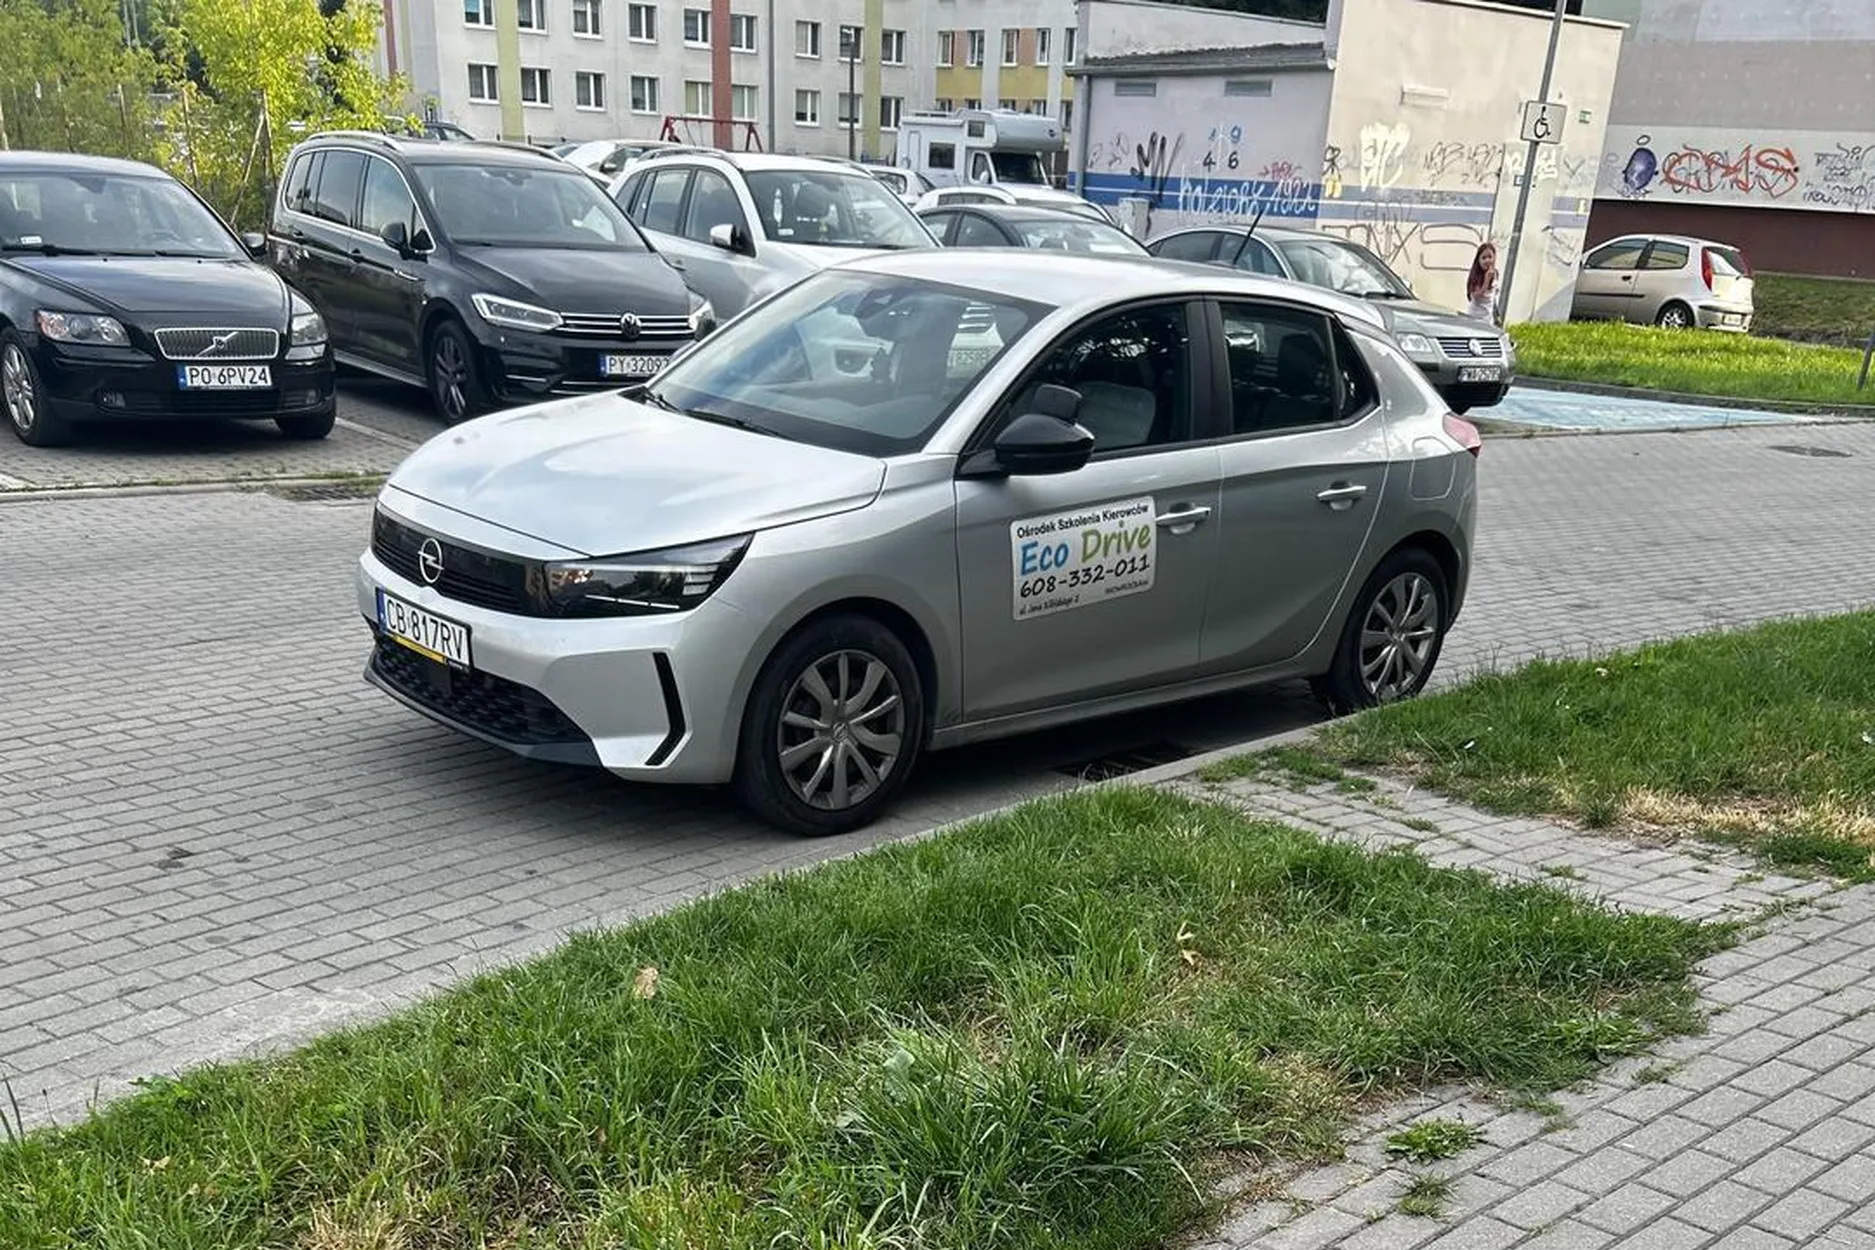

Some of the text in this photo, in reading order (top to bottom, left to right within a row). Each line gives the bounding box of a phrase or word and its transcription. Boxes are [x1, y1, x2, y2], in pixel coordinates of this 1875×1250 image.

[188, 367, 269, 385] PO 6PV24
[609, 357, 626, 372] PY
[1016, 503, 1149, 539] Ośrodek Szkolenia Kierowców
[1020, 520, 1151, 576] Eco Drive
[1020, 554, 1150, 598] 608-332-011
[386, 599, 463, 660] CB 817RV
